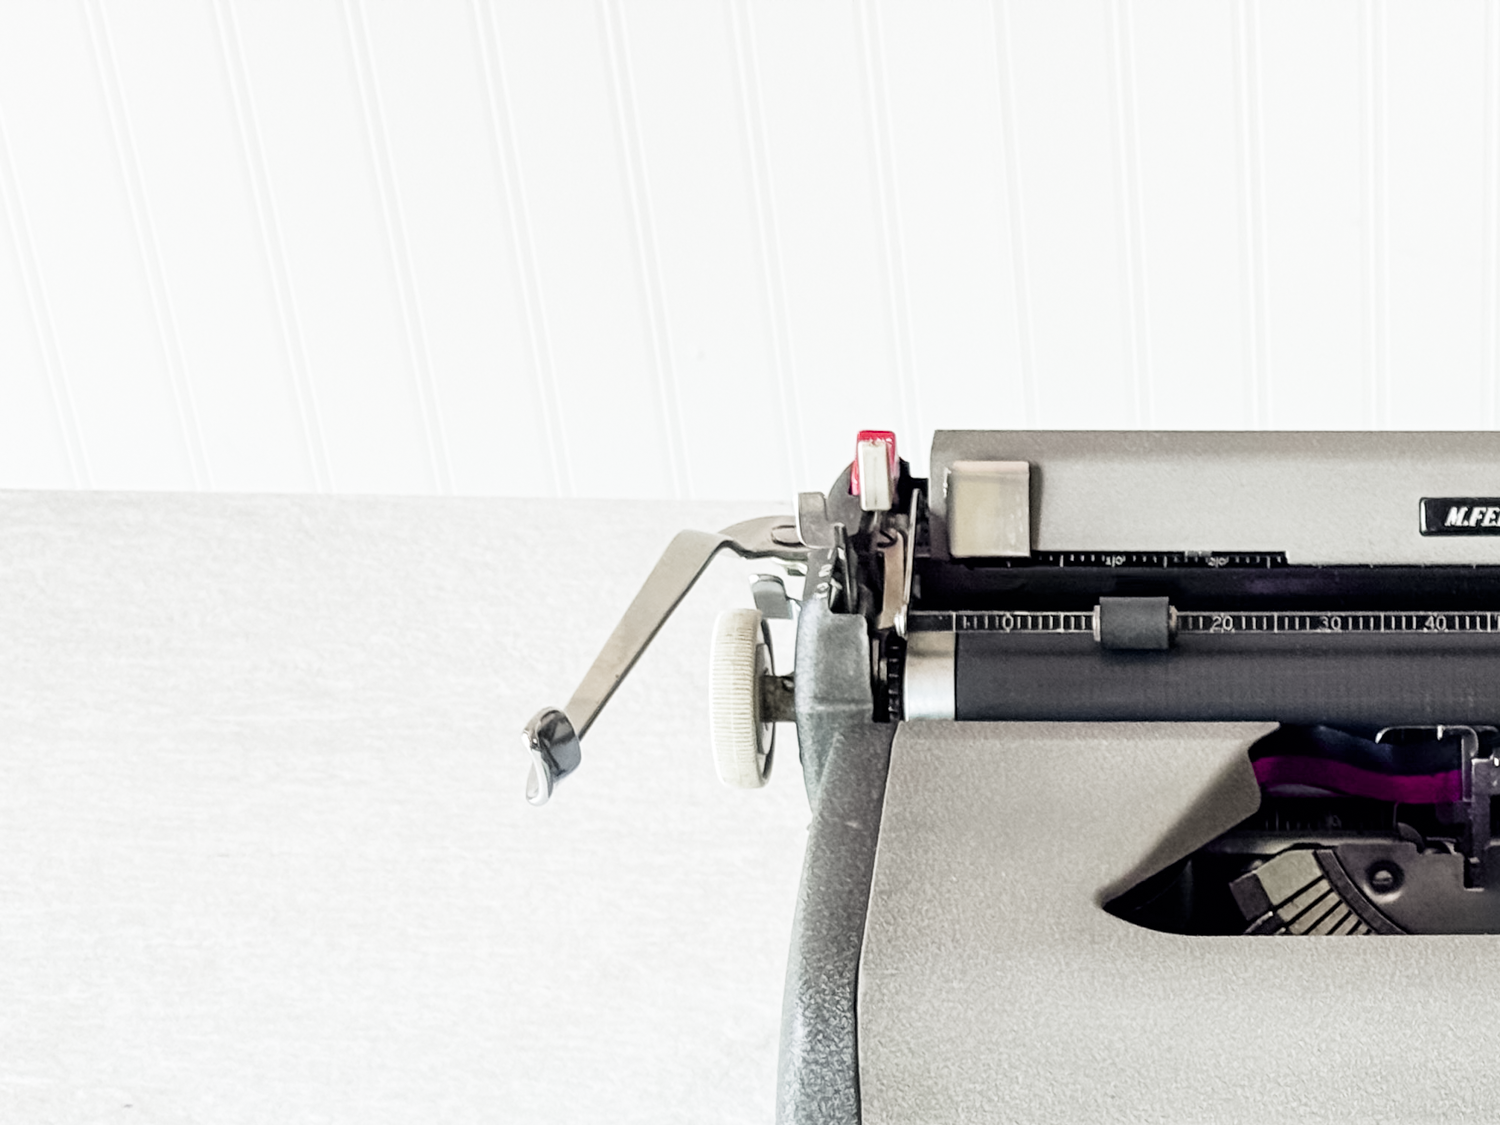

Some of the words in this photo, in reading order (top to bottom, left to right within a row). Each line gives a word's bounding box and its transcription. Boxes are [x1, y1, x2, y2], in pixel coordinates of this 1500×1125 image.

[1211, 615, 1234, 631] 20
[1320, 615, 1342, 631] 30
[1425, 615, 1448, 631] 40
